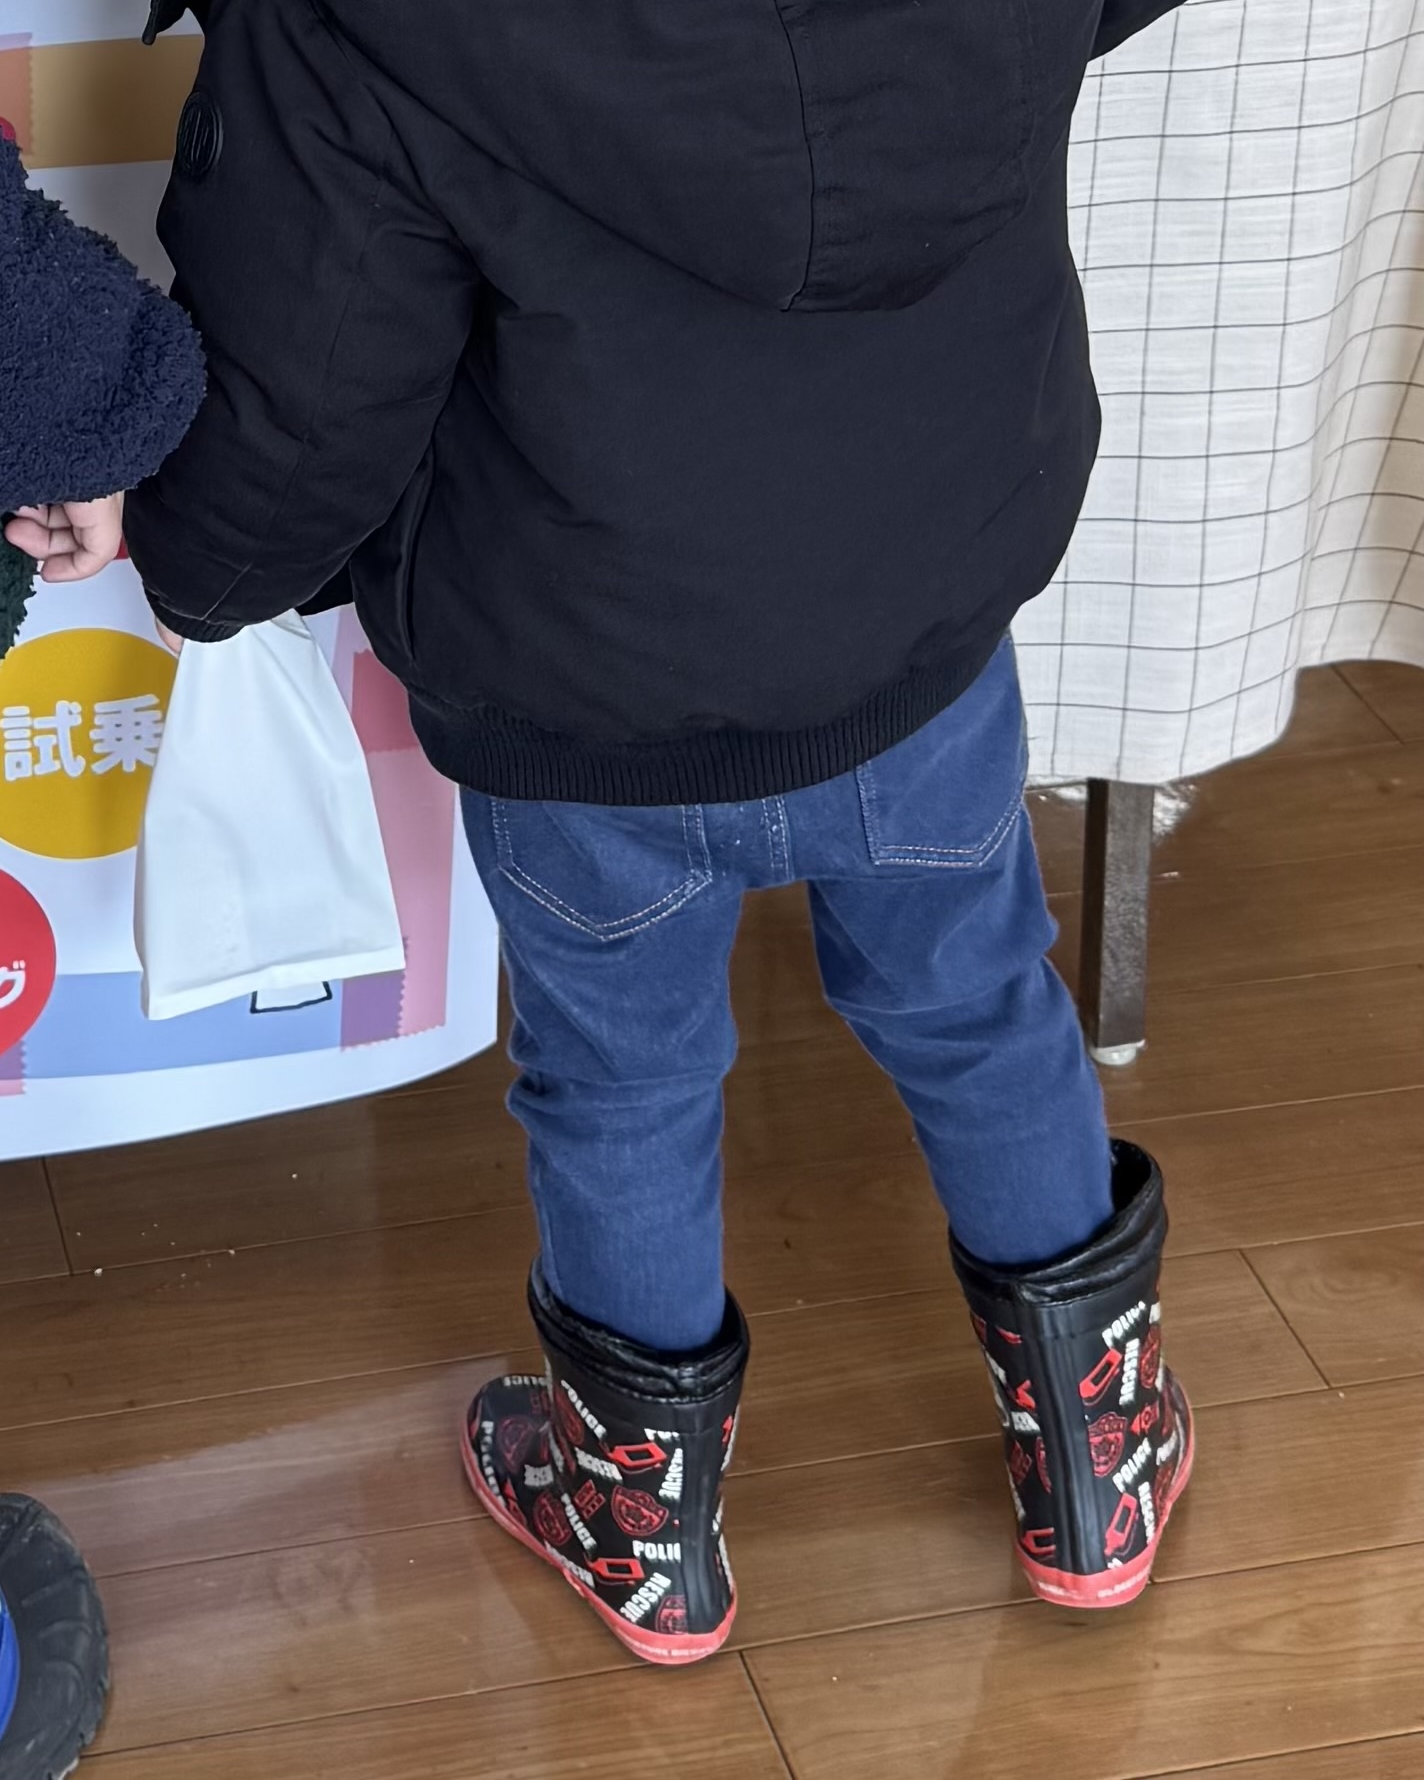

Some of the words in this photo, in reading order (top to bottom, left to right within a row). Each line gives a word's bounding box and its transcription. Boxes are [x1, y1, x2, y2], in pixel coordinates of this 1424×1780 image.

[0, 694, 164, 782] 試乗
[1112, 1437, 1153, 1494] POLICE
[560, 1492, 598, 1552] POLICE
[619, 1571, 673, 1624] RESCUE
